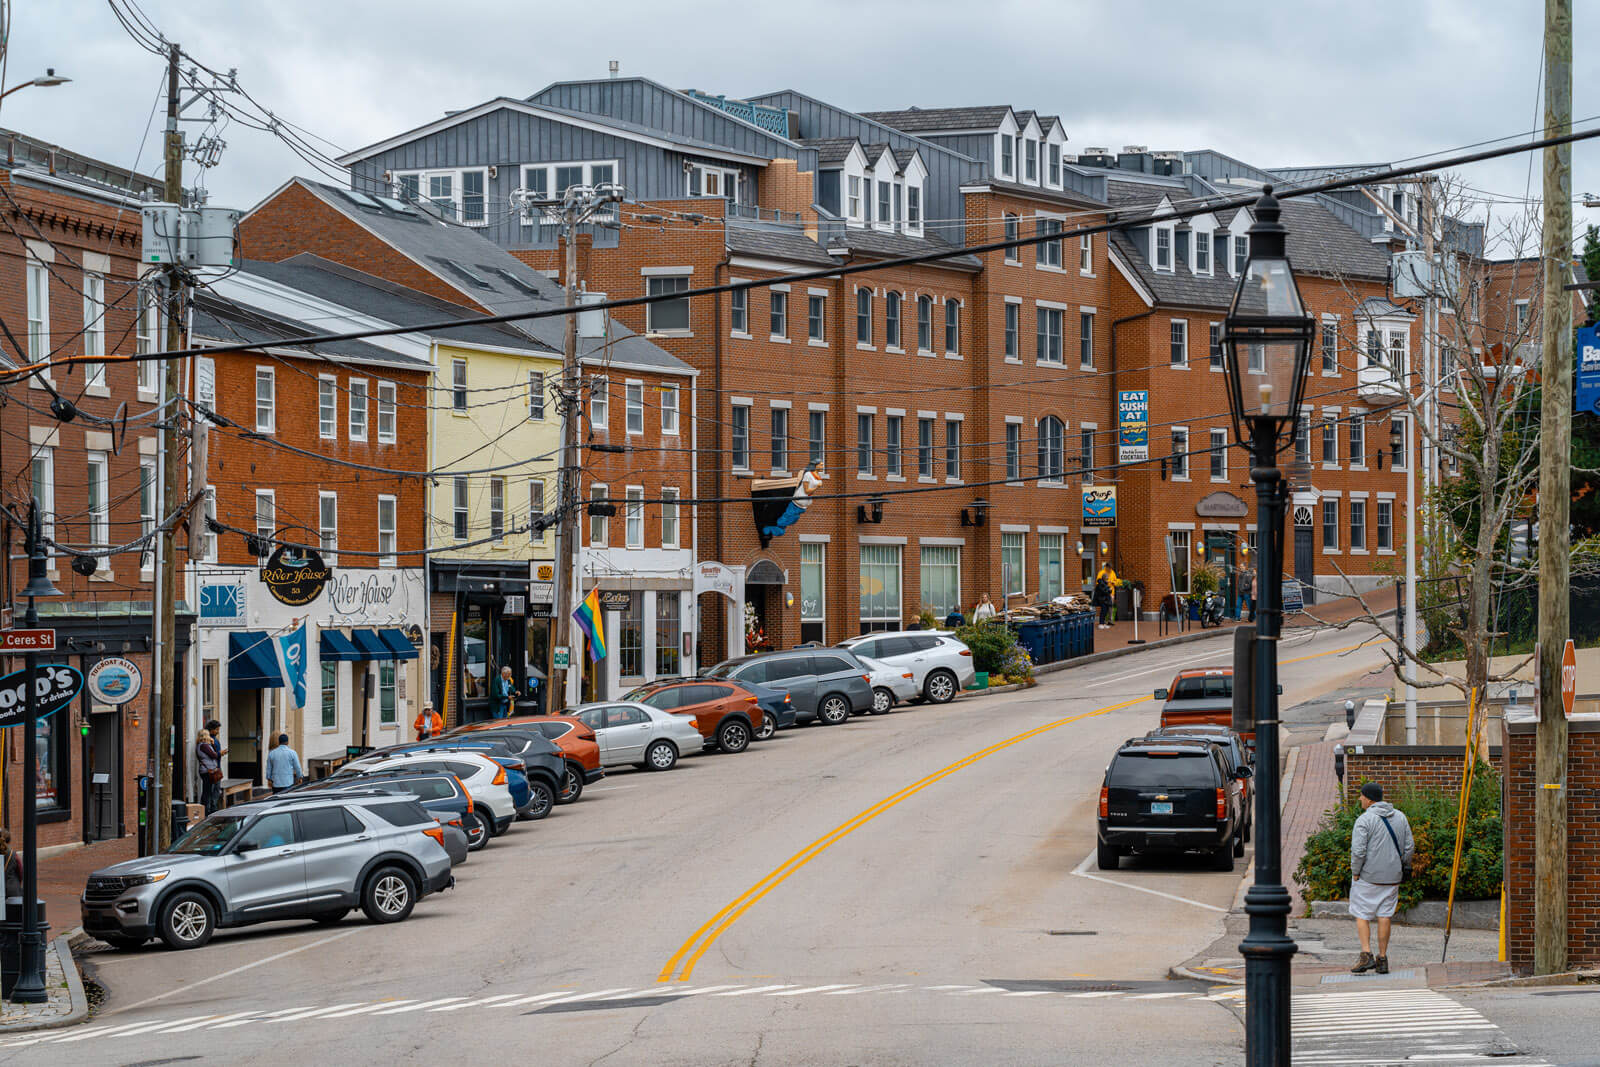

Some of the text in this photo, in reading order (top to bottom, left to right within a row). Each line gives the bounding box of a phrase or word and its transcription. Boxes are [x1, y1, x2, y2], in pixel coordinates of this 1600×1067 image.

[1122, 392, 1145, 401] EAT
[1125, 412, 1142, 420] AT
[1086, 490, 1112, 503] Surf
[262, 568, 293, 585] River
[200, 585, 239, 606] SIX
[328, 574, 360, 615] River
[7, 634, 52, 645] Ceres St
[90, 658, 138, 677] TUGBOAT ALLEY
[1562, 665, 1576, 693] STOP
[49, 689, 74, 702] drinks
